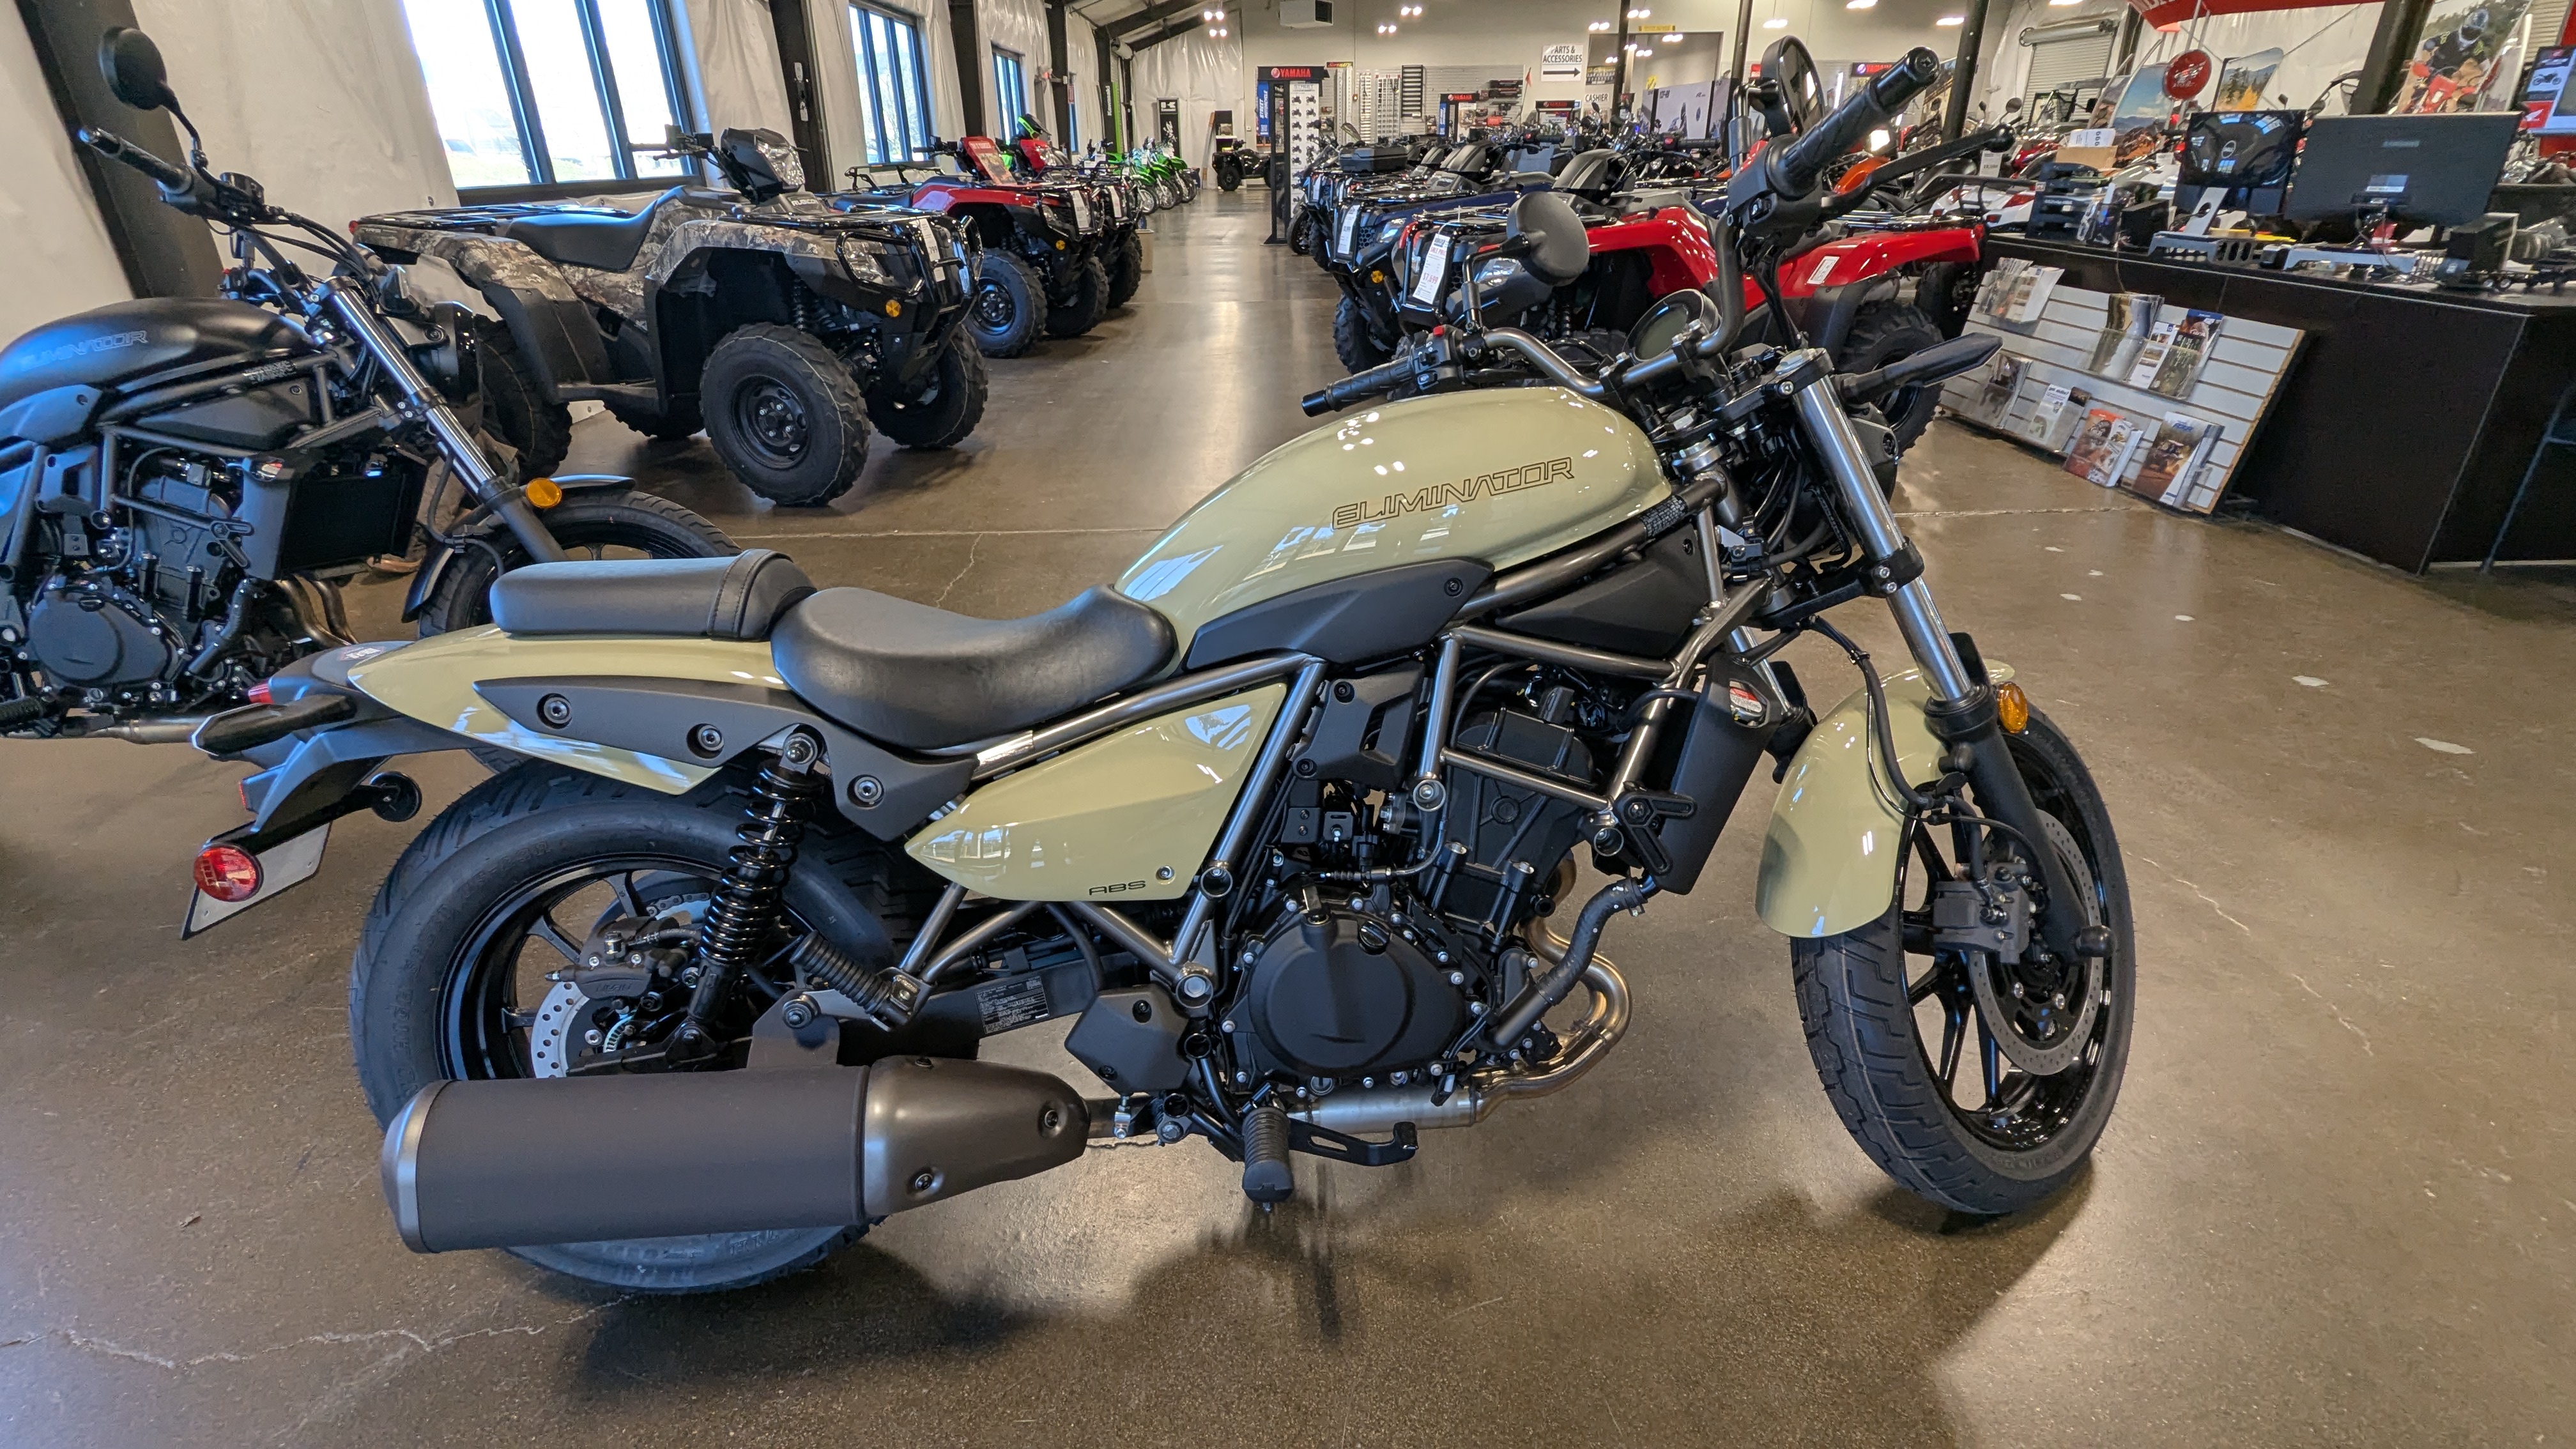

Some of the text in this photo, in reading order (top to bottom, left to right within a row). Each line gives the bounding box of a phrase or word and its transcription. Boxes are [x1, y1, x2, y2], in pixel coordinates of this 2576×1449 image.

[1570, 45, 1575, 54] &
[1542, 54, 1583, 63] ACCESSORIES
[1280, 68, 1312, 78] YAMAHA
[1585, 93, 1608, 102] CASHIER
[1332, 456, 1575, 530] ELIMINATOR
[1089, 880, 1146, 896] ABS
